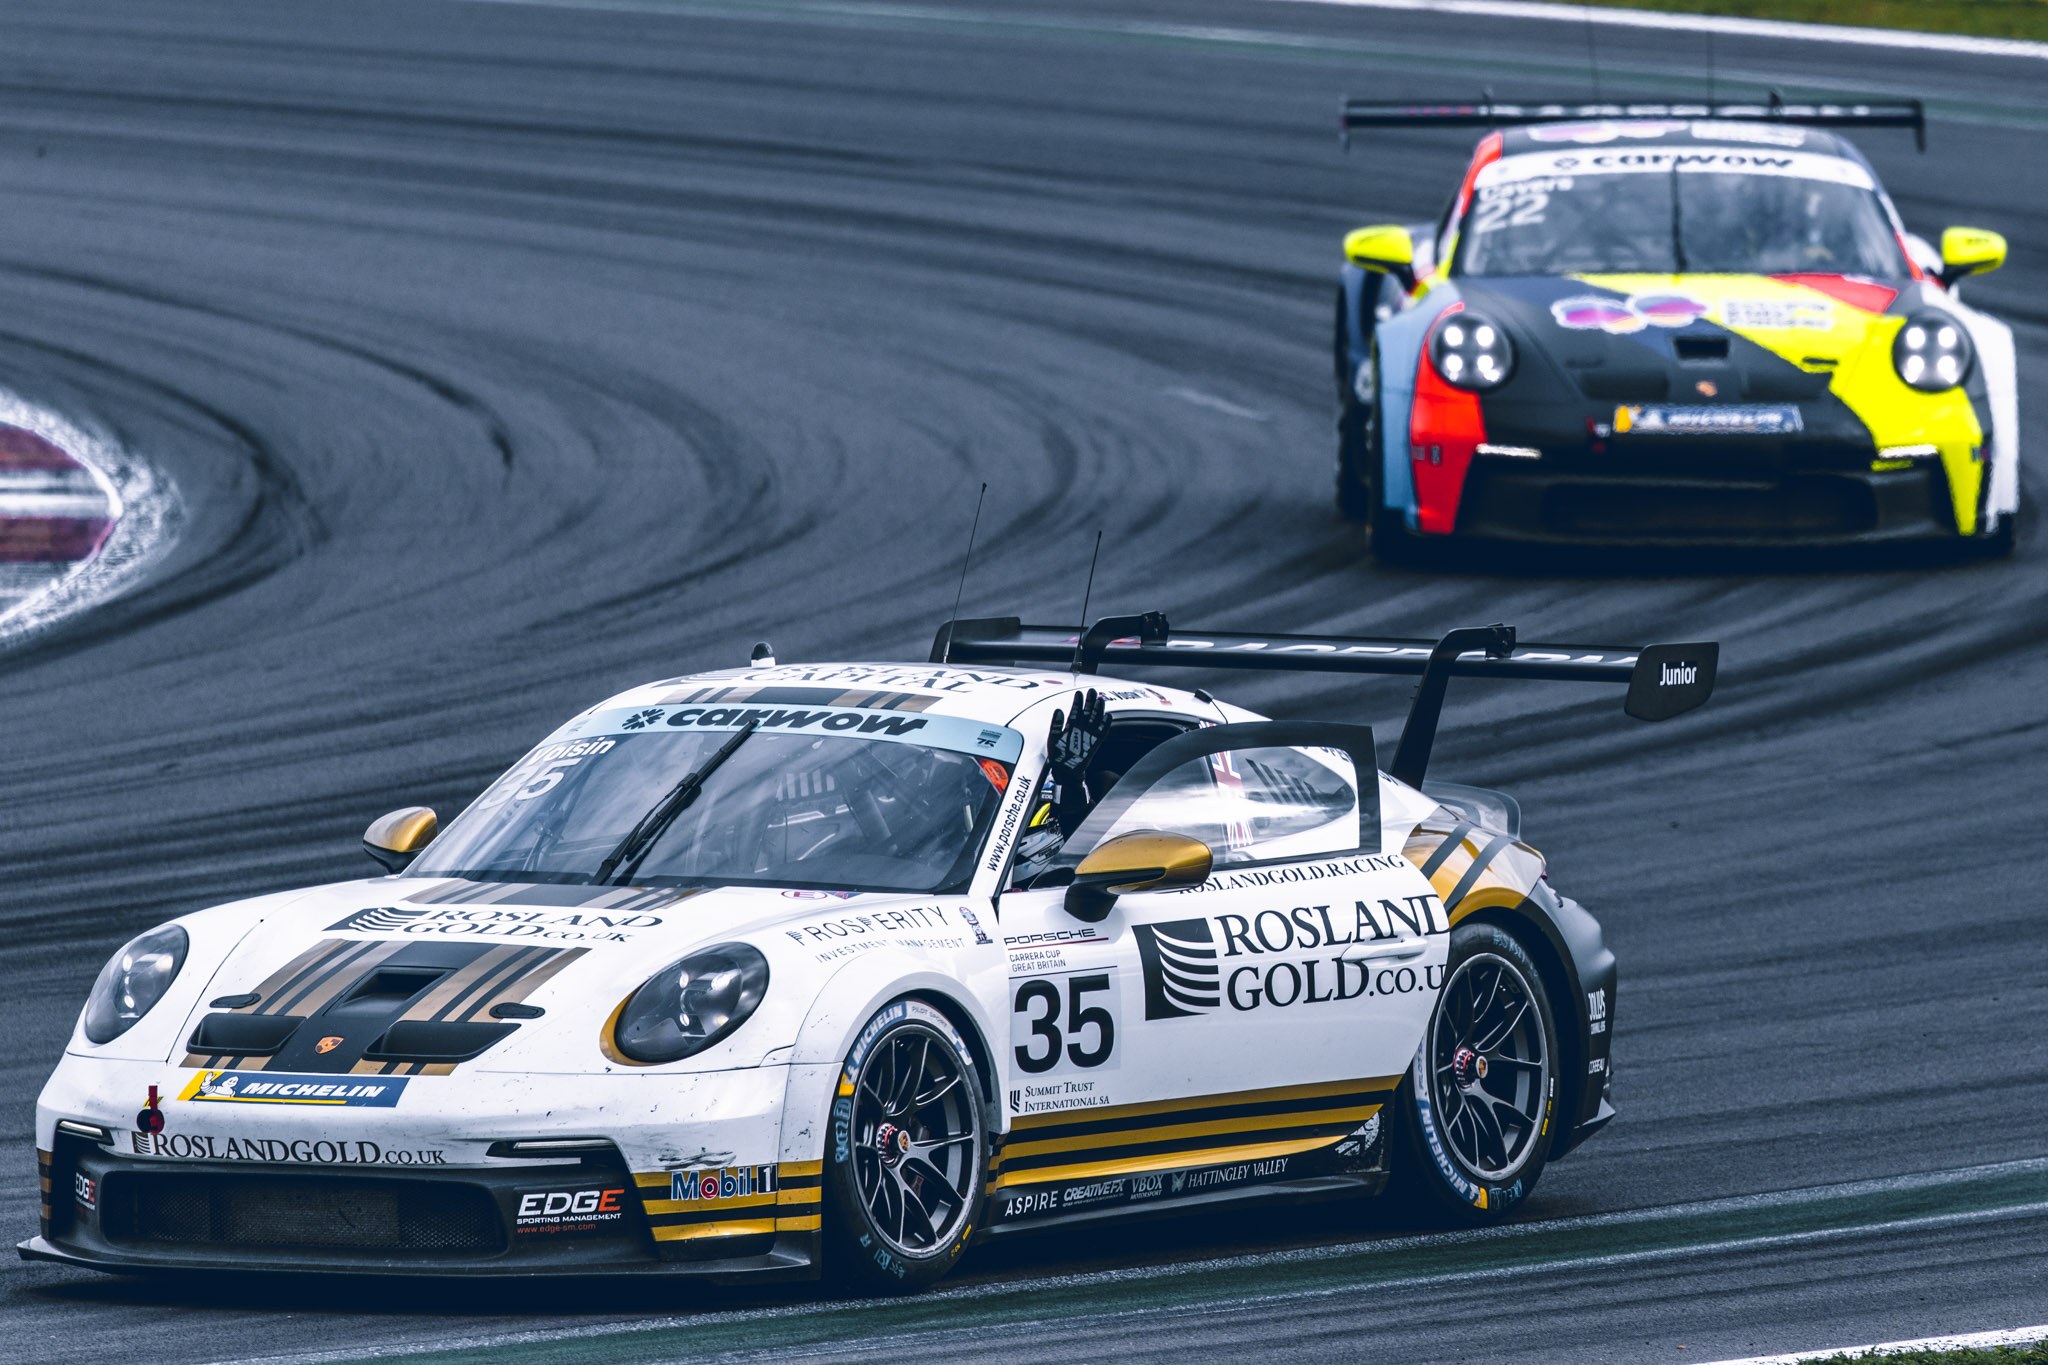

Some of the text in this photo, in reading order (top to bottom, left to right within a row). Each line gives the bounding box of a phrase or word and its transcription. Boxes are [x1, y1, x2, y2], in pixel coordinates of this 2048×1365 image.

[1473, 193, 1549, 233] 22
[1660, 661, 1697, 686] Junior
[666, 707, 928, 736] carwow
[987, 776, 1032, 872] www.porsche.co.uk
[425, 910, 663, 928] ROSLAND
[785, 905, 949, 946] PROSPERITY
[1214, 893, 1450, 957] ROSLAND
[1004, 928, 1096, 945] PORSCHE
[815, 938, 889, 964] INVESTMENT
[1009, 949, 1061, 963] CARRERA CUP
[1012, 959, 1067, 973] GREAT BRITAIN
[852, 1004, 903, 1066] MICHELIN
[1014, 973, 1115, 1074] 35
[240, 1082, 386, 1098] MICHELIN
[1099, 1097, 1110, 1105] SA
[153, 1133, 447, 1165] ROSLANDGOLD.CO.UK
[671, 1165, 777, 1201] Mobil 1
[1131, 1174, 1164, 1193] VBOX
[1188, 1158, 1289, 1188] HATTINGLEY VALLEY
[518, 1189, 625, 1216] EDGE
[1004, 1190, 1059, 1217] ASPIRE
[516, 1213, 622, 1225] SPORTING MANAGEMENT
[516, 1223, 597, 1234] www.edge-sm.com
